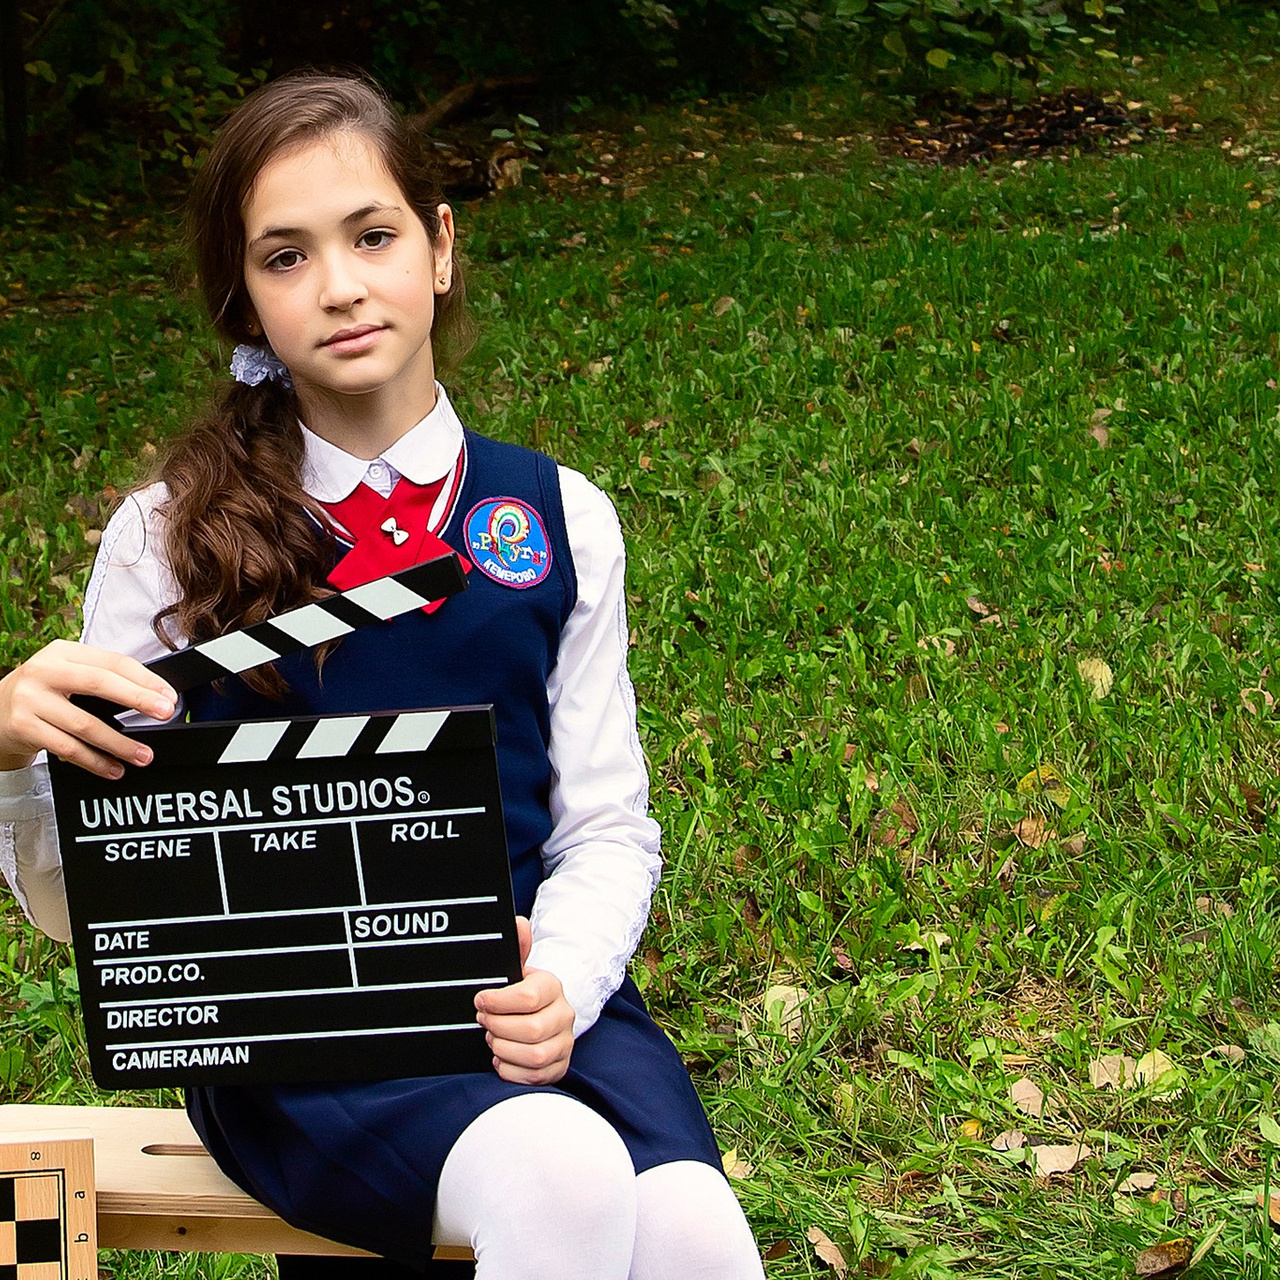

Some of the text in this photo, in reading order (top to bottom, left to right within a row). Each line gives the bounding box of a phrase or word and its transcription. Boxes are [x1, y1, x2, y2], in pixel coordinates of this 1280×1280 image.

[483, 558, 537, 584] КЕМЕРОВО
[80, 789, 263, 829] UNIVERSAL
[250, 829, 317, 853] TAKE
[391, 821, 459, 842] ROLL
[104, 837, 192, 862] SCENE
[354, 910, 449, 937] SOUND
[95, 931, 149, 951] DATE
[106, 1005, 219, 1030] DIRECTOR
[111, 1045, 250, 1071] CAMERAMAN
